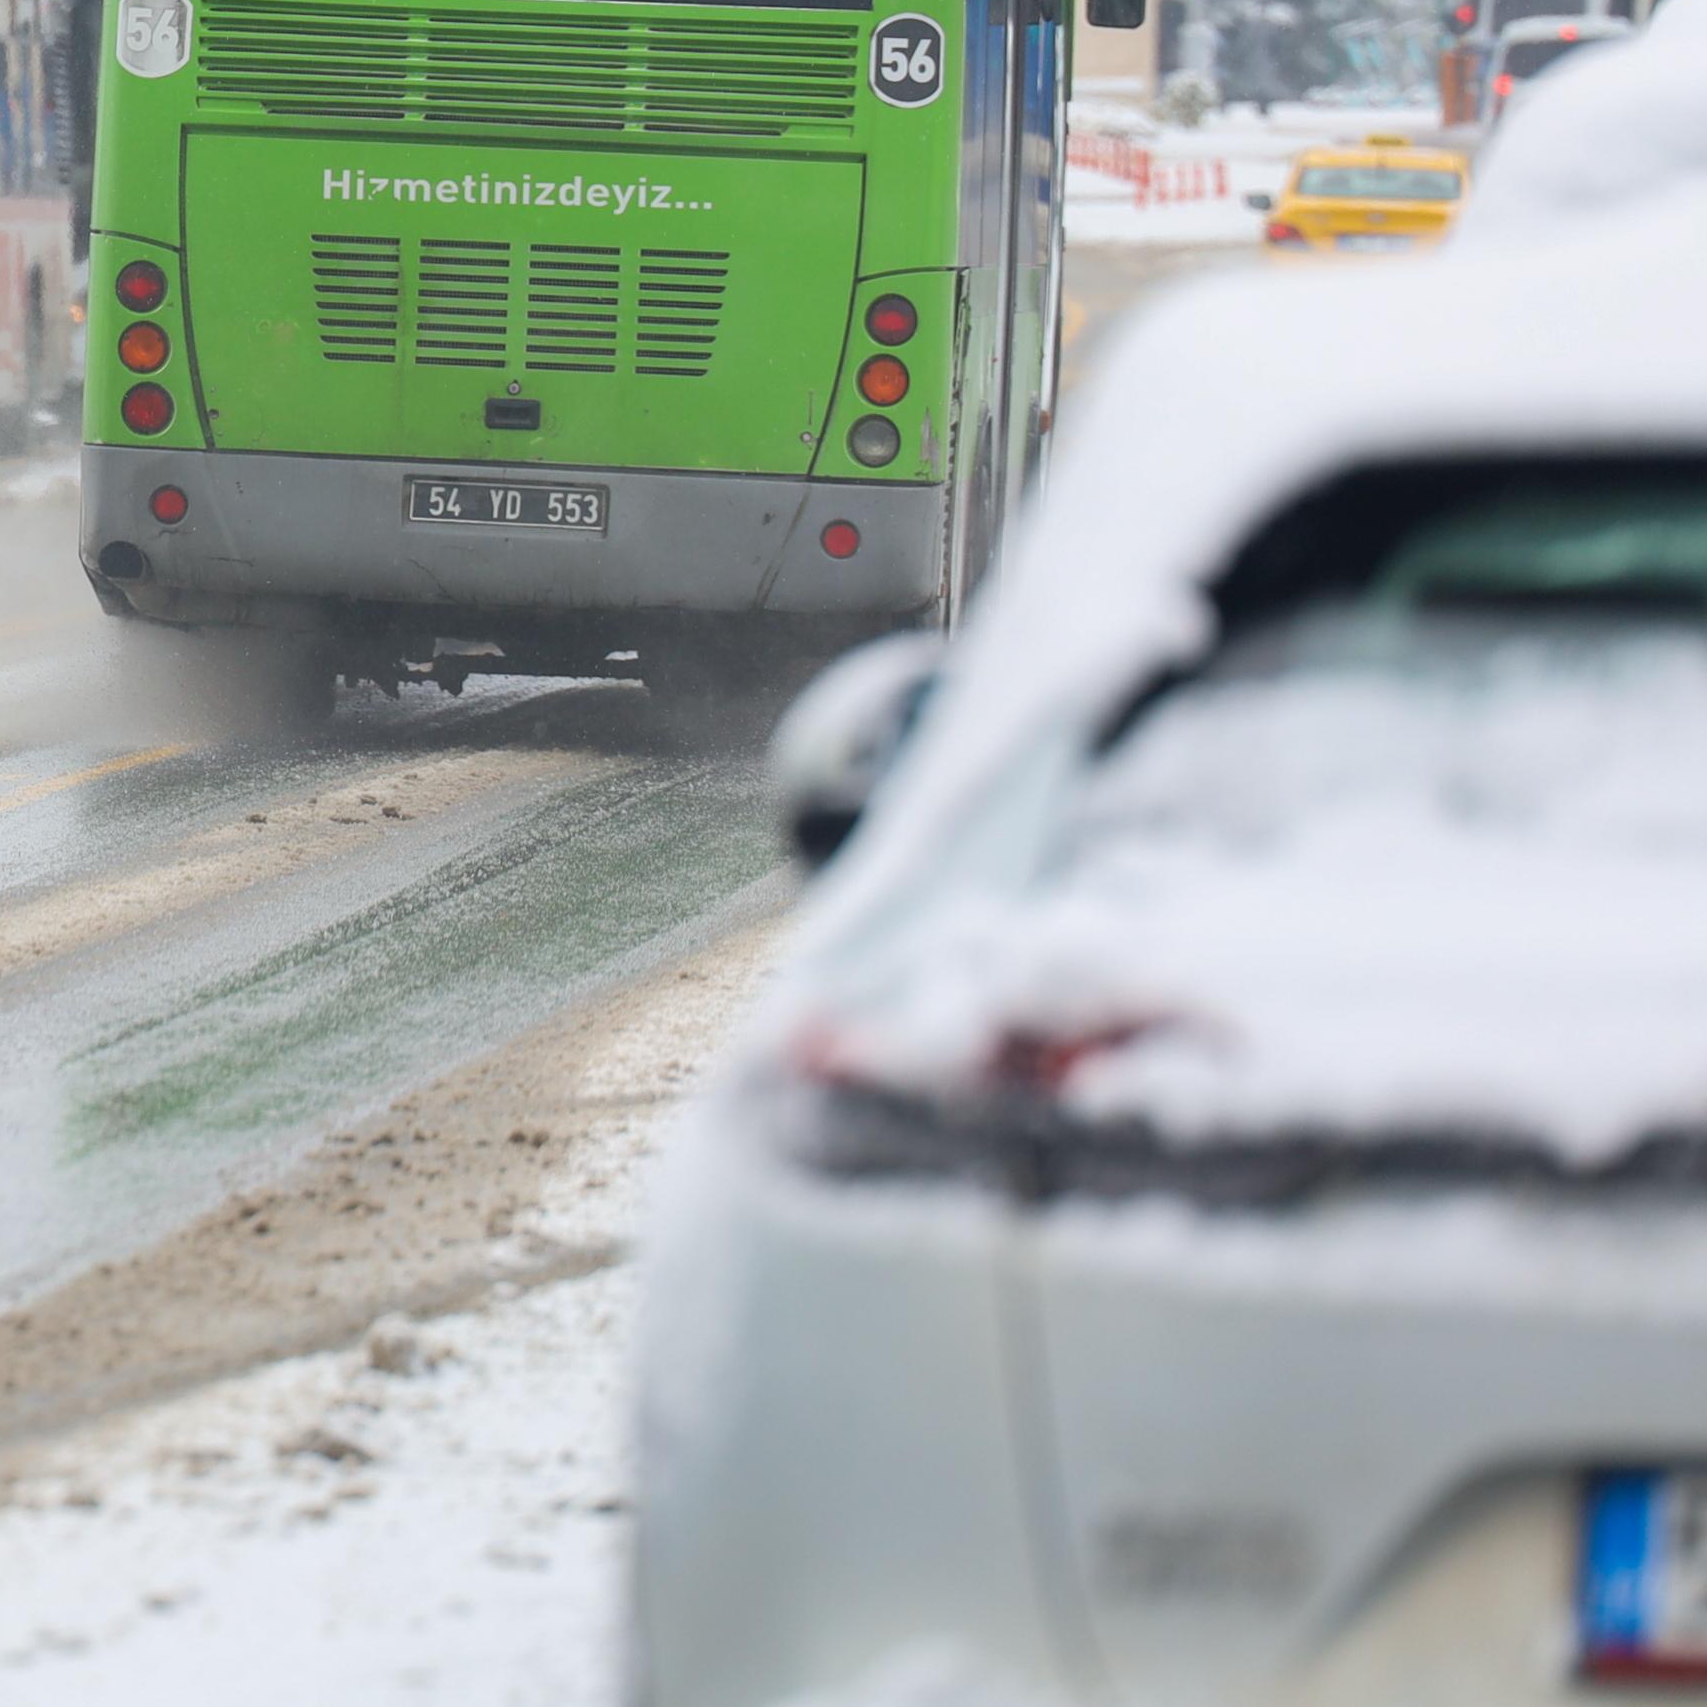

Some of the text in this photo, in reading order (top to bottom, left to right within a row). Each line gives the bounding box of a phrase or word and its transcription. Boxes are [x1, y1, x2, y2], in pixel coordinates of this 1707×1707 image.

[126, 7, 179, 54] 56
[881, 37, 936, 83] 56
[323, 169, 713, 215] Hizmetinizdeyiz...
[429, 487, 599, 524] 54 YD 553
